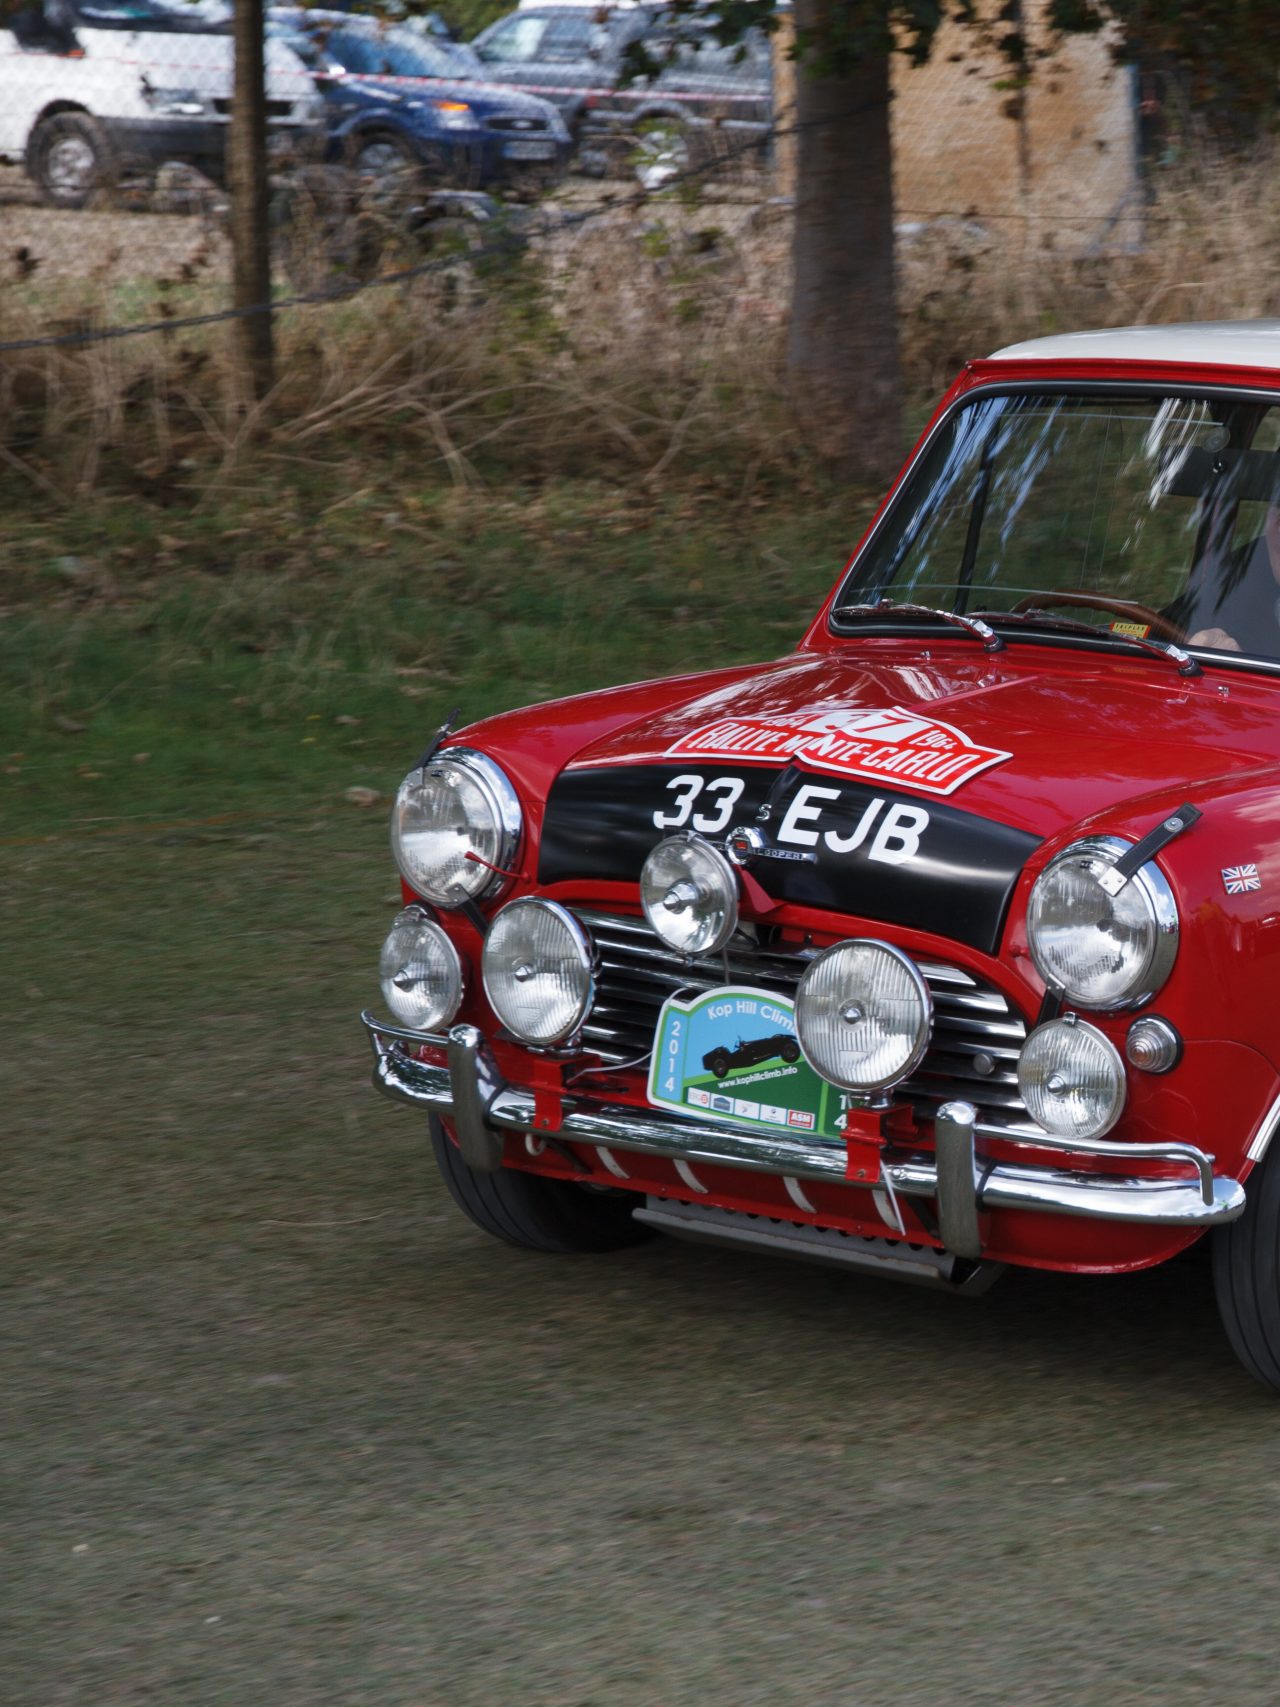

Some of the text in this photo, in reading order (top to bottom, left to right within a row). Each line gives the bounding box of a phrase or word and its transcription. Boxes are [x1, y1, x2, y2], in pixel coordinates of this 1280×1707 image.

[686, 722, 980, 782] RALLYE MNTE-CARLO
[909, 729, 957, 750] 1964
[653, 774, 930, 865] 33 EJB
[707, 1000, 796, 1033] Kop Hill Clim
[665, 1020, 681, 1093] 2014
[718, 1065, 798, 1089] www.kophillclimb.info
